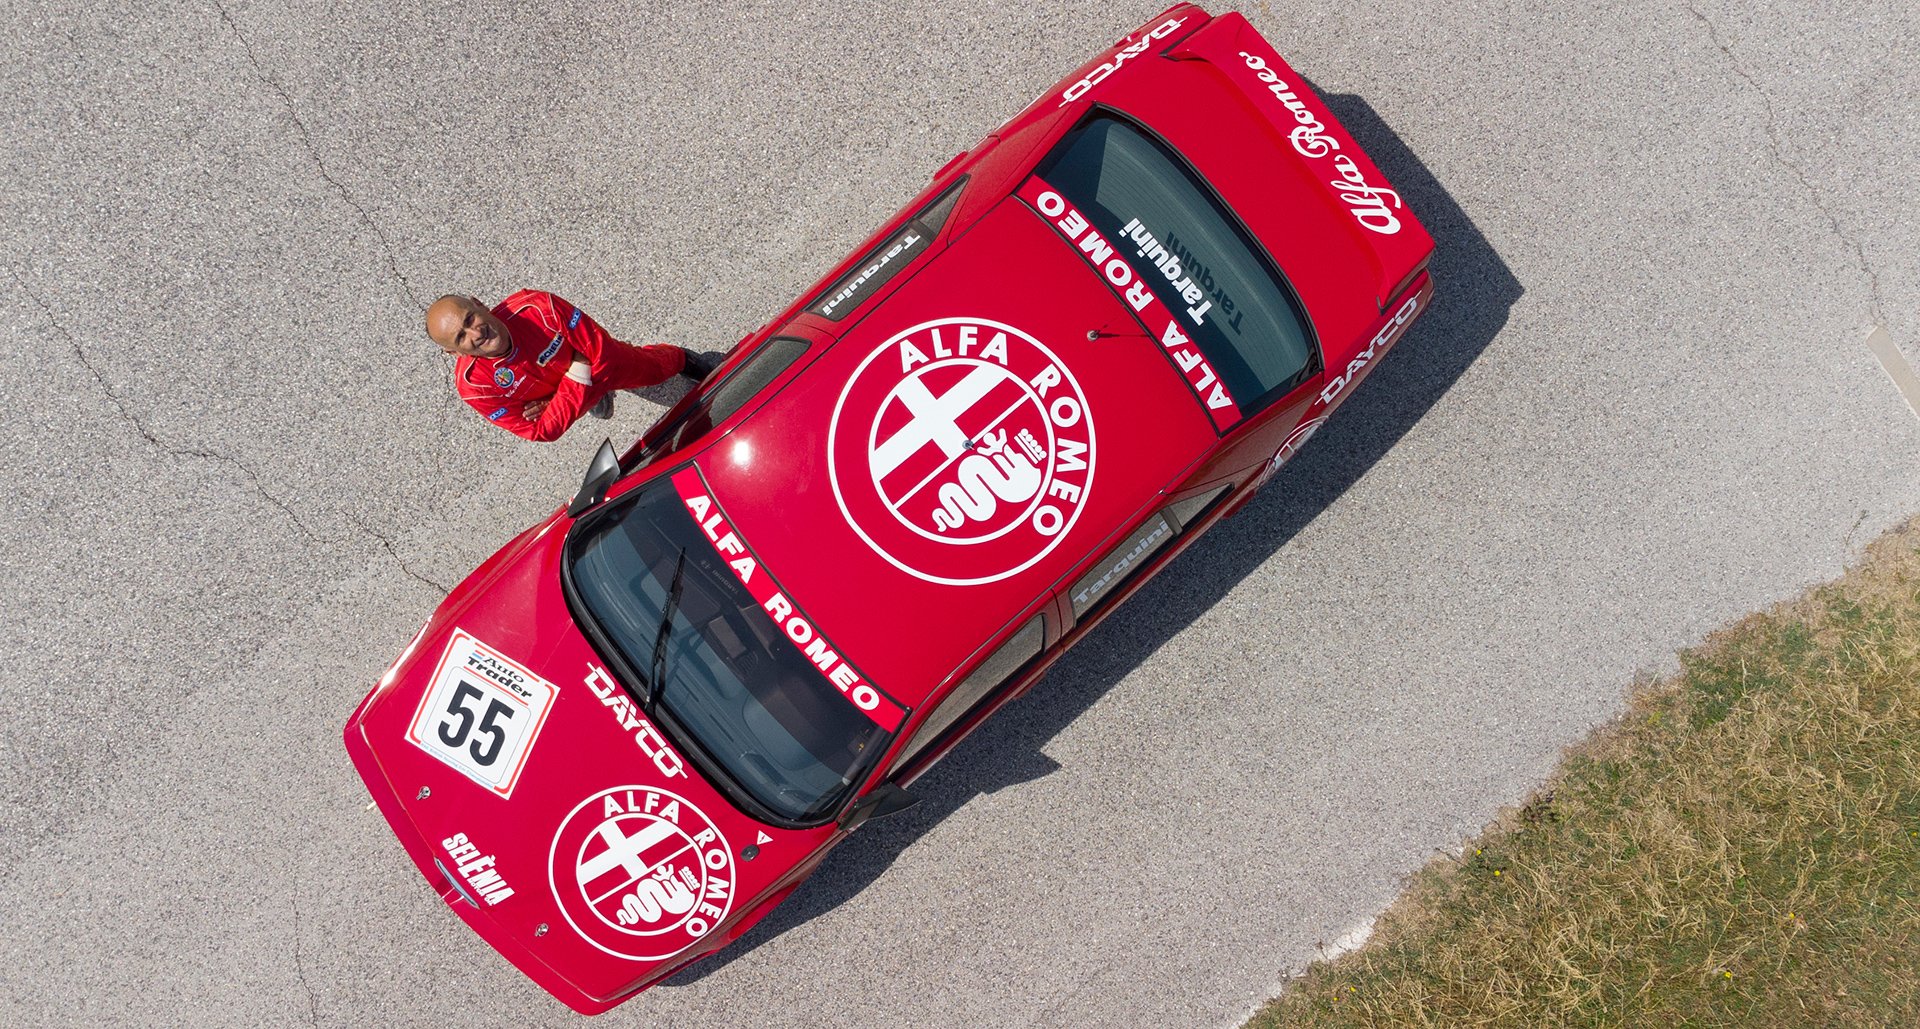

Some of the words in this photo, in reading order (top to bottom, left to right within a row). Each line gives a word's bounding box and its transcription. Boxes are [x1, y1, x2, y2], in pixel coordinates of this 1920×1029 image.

[1059, 16, 1188, 108] DAYCO
[1238, 51, 1340, 159] Romeo
[1330, 154, 1401, 235] Alfa
[822, 233, 921, 316] Tarquini
[1036, 190, 1155, 313] ROMEO
[1118, 217, 1213, 326] Tarquini
[1161, 319, 1233, 412] ALFA
[1314, 289, 1423, 406] DAYCO
[899, 325, 1009, 374] ALFA
[1029, 364, 1088, 537] ROMEO
[685, 494, 758, 585] ALFA
[763, 591, 880, 711] ROMEO
[1073, 520, 1170, 604] Tarquini
[466, 656, 533, 698] Trader
[482, 657, 524, 683] Auto
[437, 679, 515, 767] 55
[583, 662, 689, 779] DAYCO
[604, 790, 680, 825] ALFA
[685, 827, 730, 938] ROMEO
